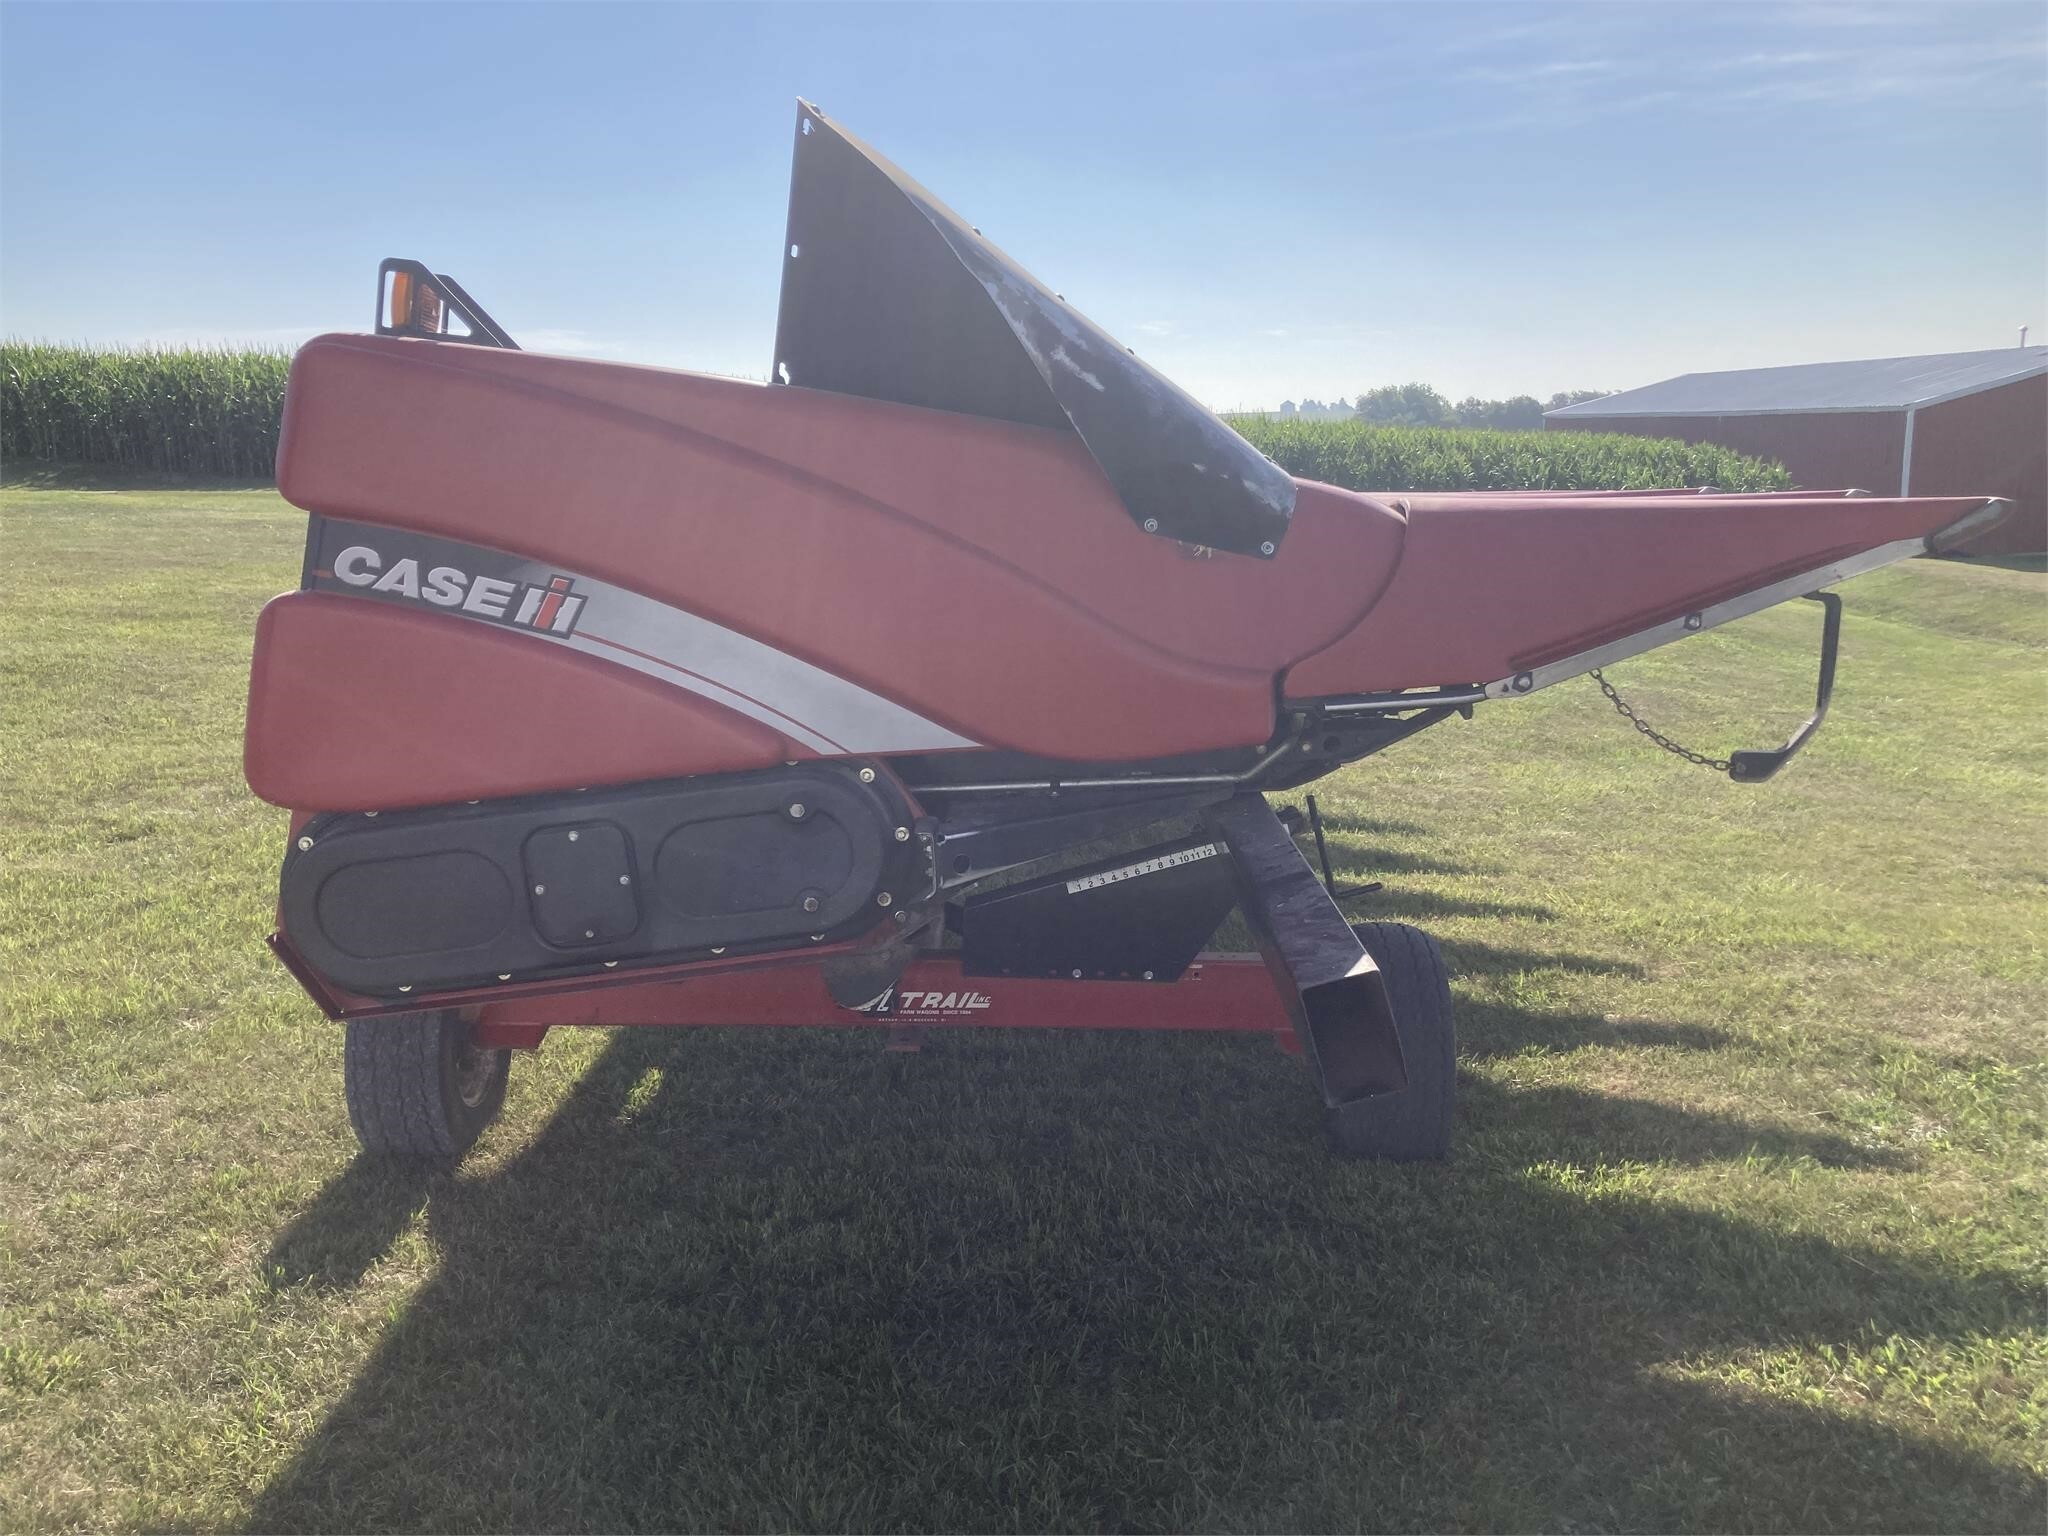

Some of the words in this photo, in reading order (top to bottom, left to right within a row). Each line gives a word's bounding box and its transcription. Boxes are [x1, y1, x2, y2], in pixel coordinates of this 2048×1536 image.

[334, 546, 517, 617] CASE
[1088, 880, 1094, 888] 2
[1099, 877, 1106, 885] 3
[1169, 858, 1175, 866] 9
[1180, 854, 1190, 863] 10
[1191, 852, 1201, 860] 11
[1203, 848, 1213, 857] 12
[900, 991, 991, 1009] TRAIL
